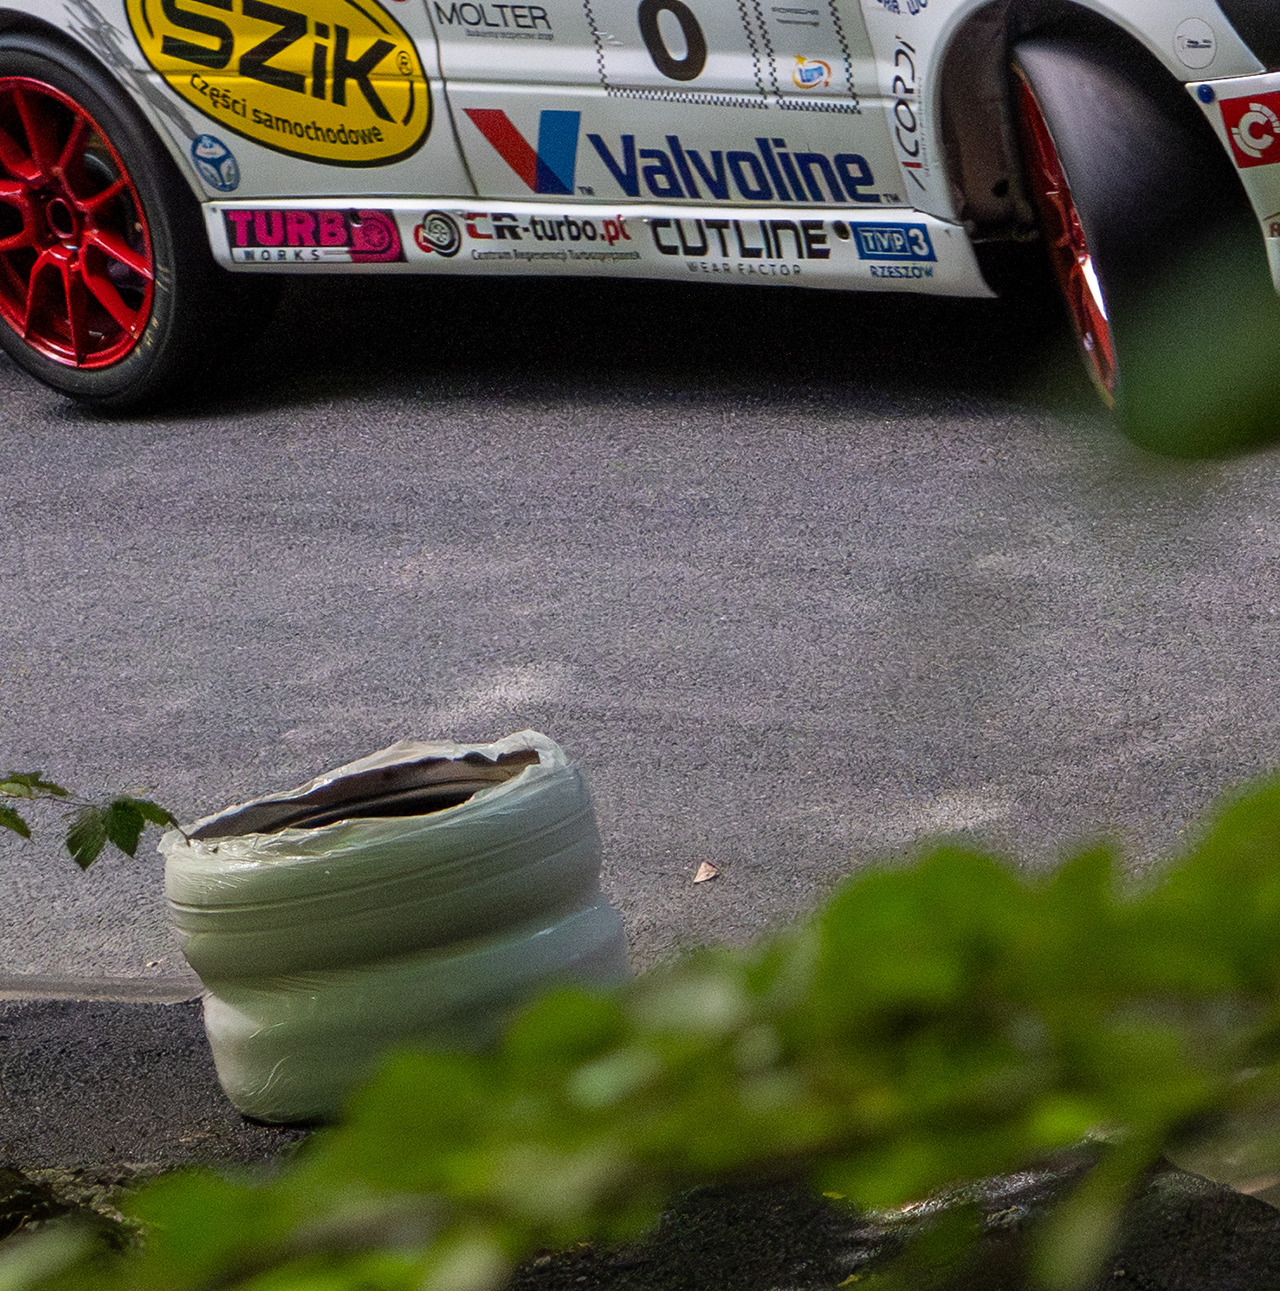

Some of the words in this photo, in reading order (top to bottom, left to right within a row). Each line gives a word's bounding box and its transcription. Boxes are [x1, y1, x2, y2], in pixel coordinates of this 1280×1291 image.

[433, 1, 552, 30] MOLTER
[252, 108, 384, 146] samochodowe
[587, 133, 883, 203] Valvoline
[651, 218, 831, 260] CUTLINE
[861, 230, 906, 253] TVP
[910, 227, 930, 257] 3
[244, 250, 320, 261] WORKS
[687, 262, 730, 275] WEAR
[737, 263, 802, 277] FACTOR
